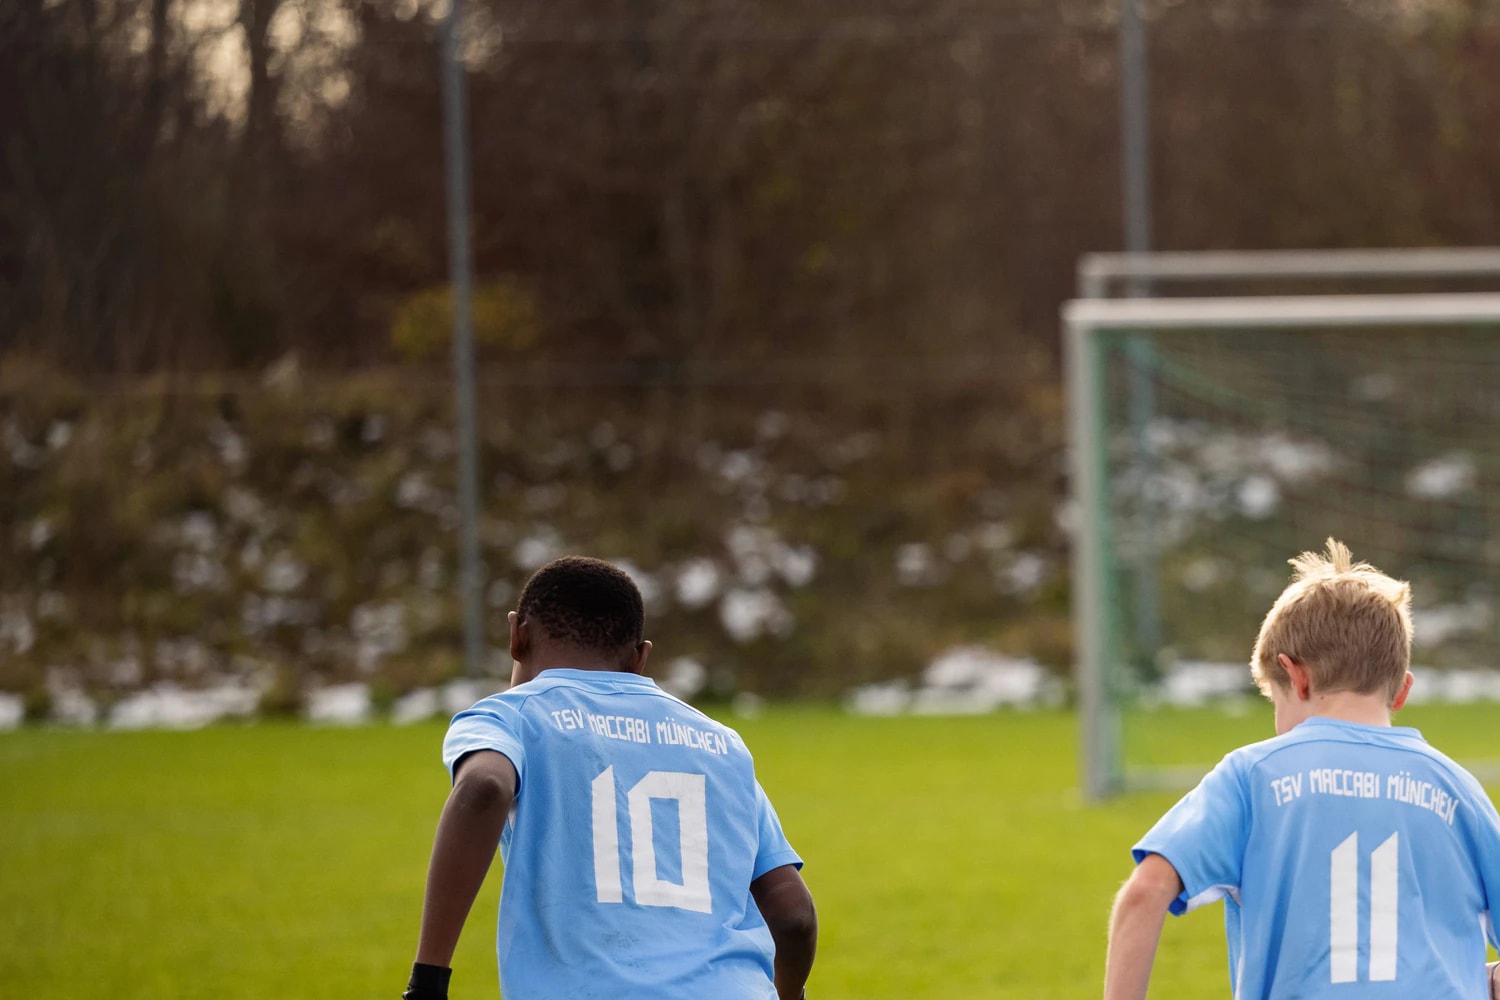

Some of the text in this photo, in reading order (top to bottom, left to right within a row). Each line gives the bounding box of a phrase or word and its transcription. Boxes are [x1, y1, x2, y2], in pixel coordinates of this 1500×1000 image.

[551, 709, 728, 755] TSV MACCABI MÜNCHEN
[591, 764, 712, 914] 10
[1271, 768, 1459, 825] TSV MACCABI MÜNCHEN
[1330, 830, 1399, 984] 11
